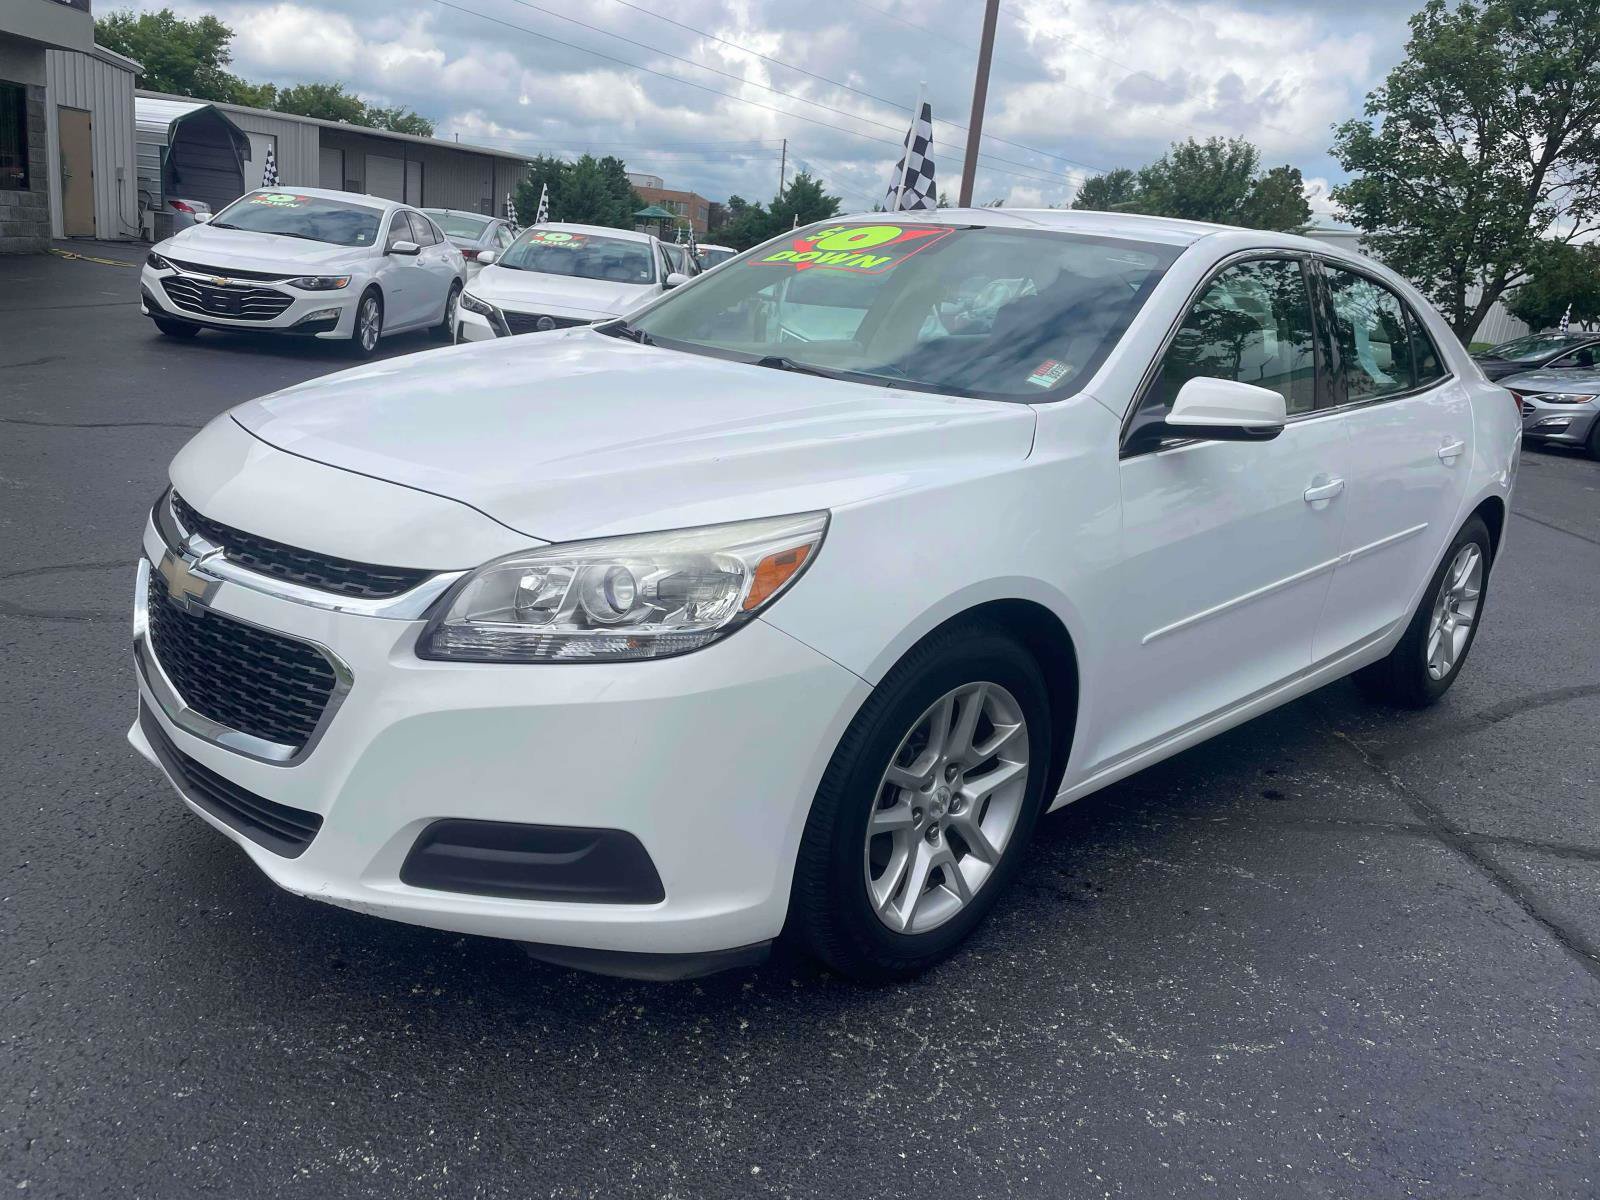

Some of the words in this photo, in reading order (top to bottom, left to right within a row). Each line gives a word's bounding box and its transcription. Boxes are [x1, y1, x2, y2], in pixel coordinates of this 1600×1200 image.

[529, 240, 580, 248] DOWN
[805, 226, 903, 251] $0
[761, 251, 893, 269] DOWN
